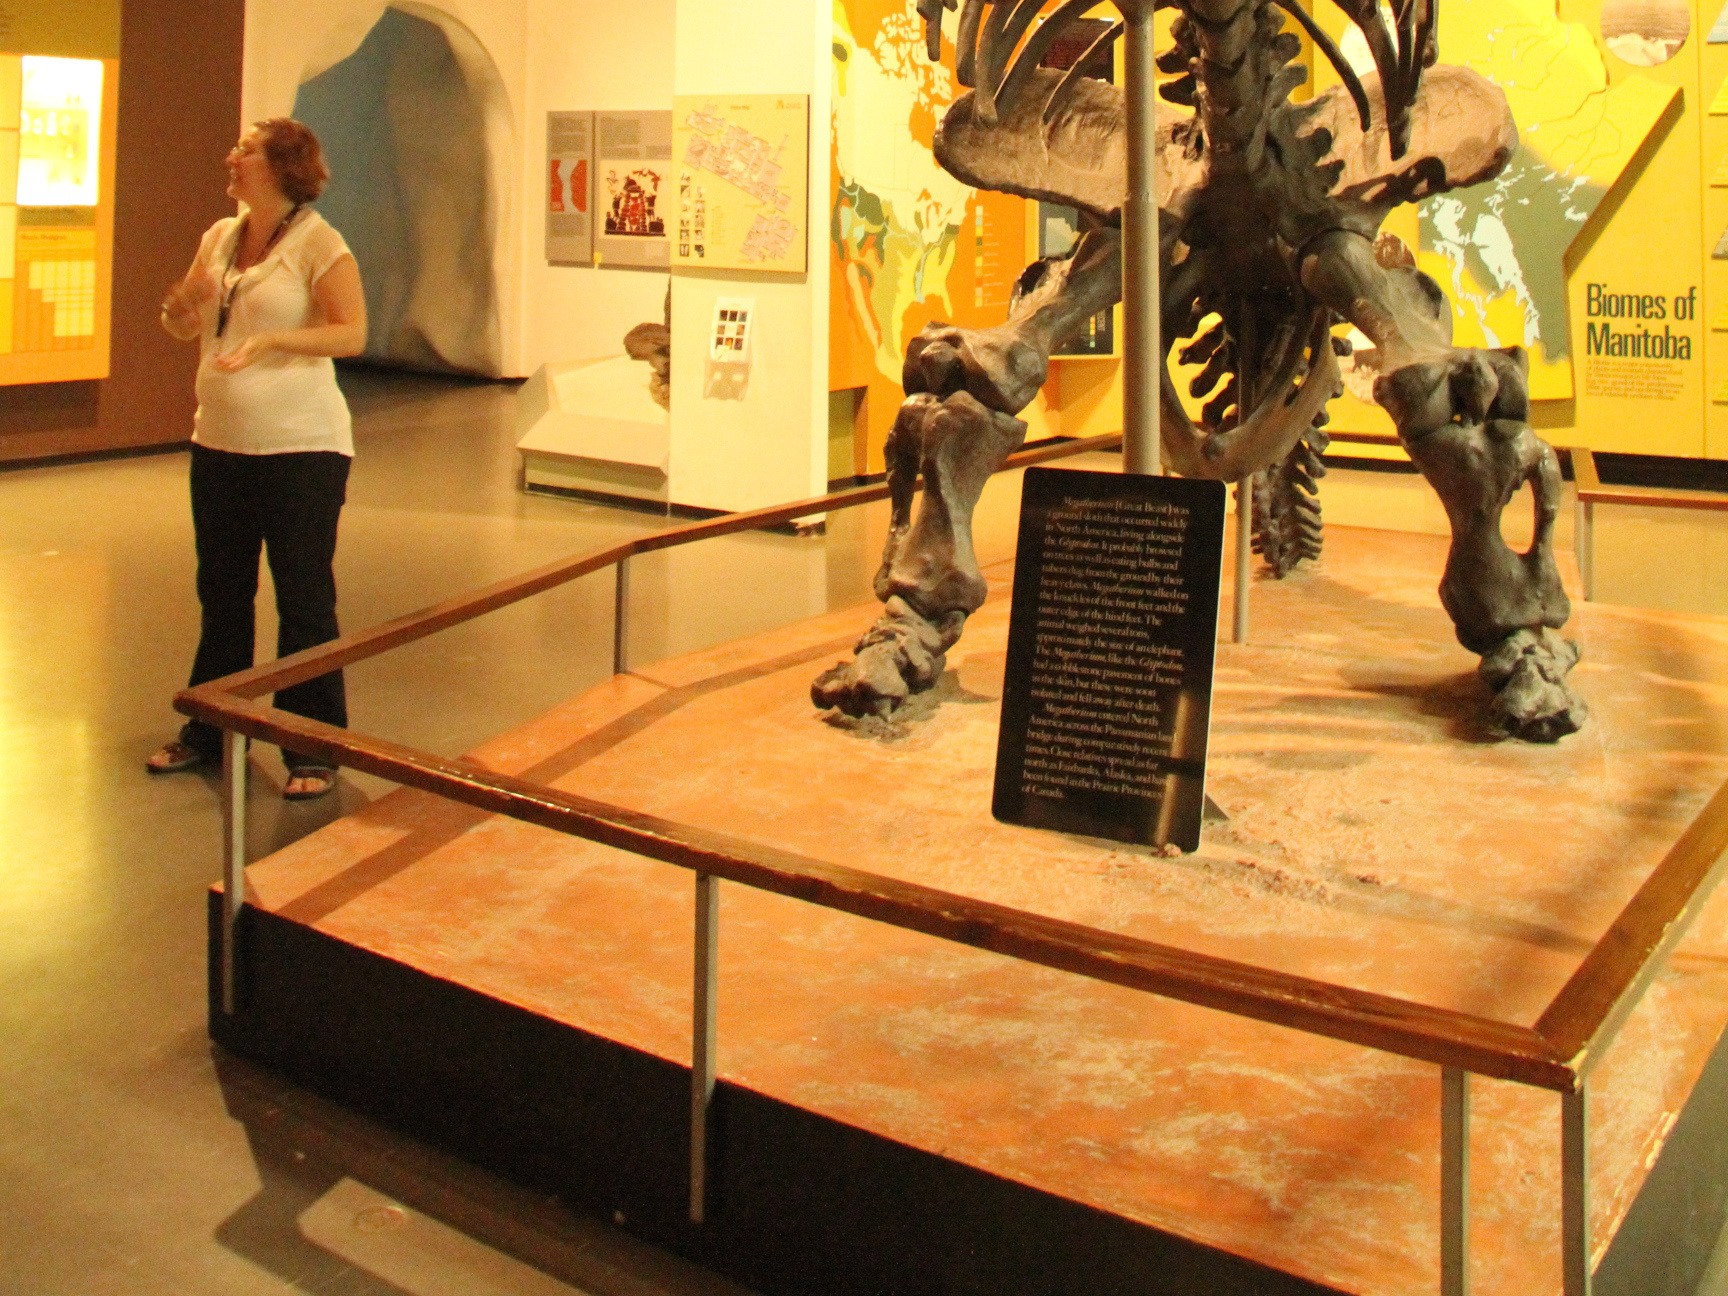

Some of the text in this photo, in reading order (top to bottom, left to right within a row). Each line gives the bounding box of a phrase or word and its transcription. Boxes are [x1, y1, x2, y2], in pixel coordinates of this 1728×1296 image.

[1587, 284, 1696, 320] Biomes of
[1587, 322, 1691, 359] Manitoba
[1052, 510, 1082, 520] ground
[1056, 522, 1081, 533] North
[1145, 587, 1176, 598] walked
[1144, 614, 1162, 625] The
[1131, 713, 1159, 726] North
